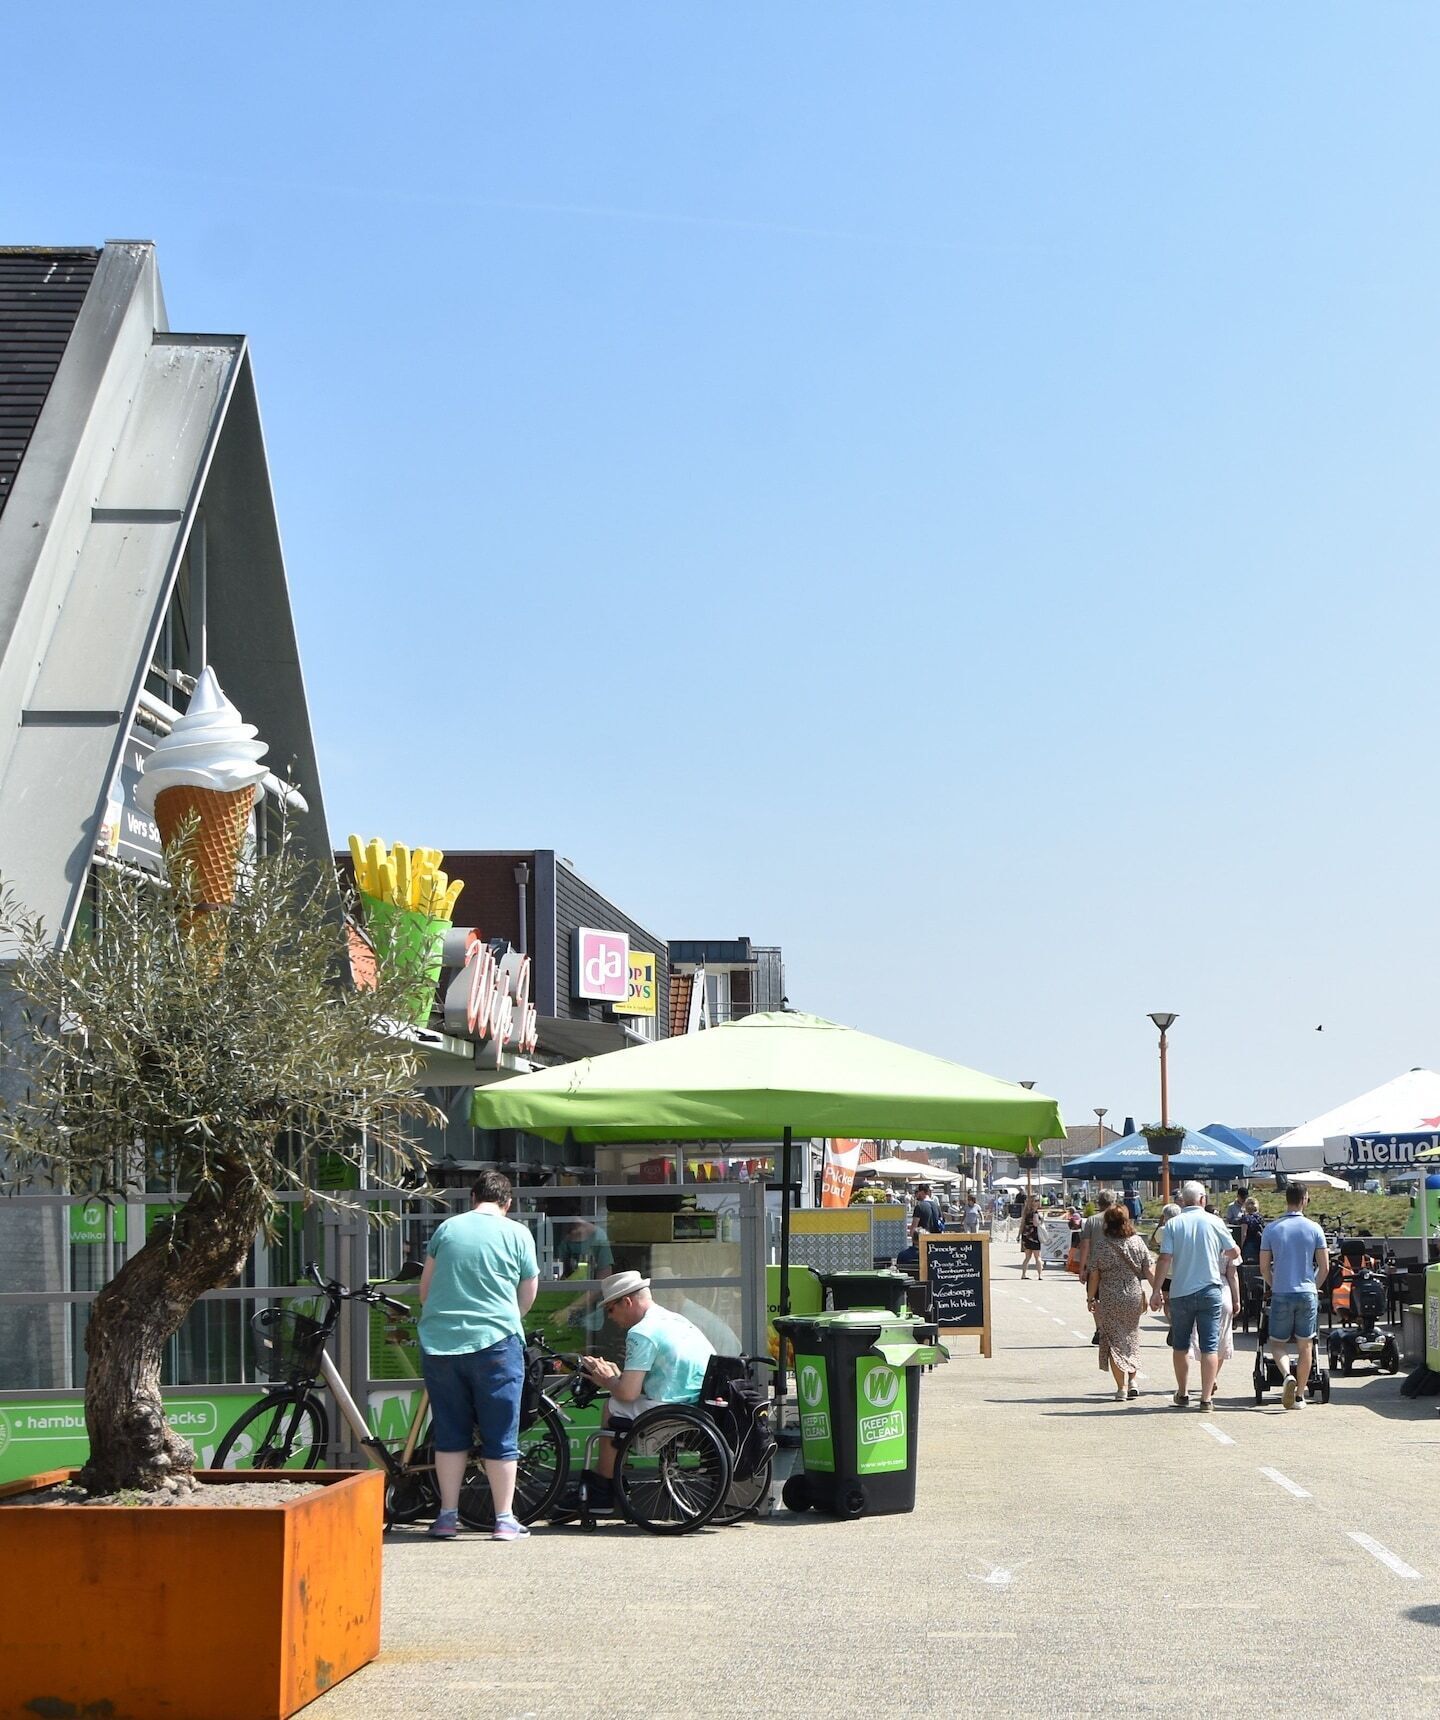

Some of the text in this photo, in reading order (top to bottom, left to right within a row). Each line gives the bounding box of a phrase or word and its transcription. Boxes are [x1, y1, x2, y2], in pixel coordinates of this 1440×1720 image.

[127, 812, 148, 836] Vers
[585, 943, 622, 986] da
[804, 1416, 826, 1426] KEEP IT
[863, 1414, 900, 1430] KEEP IT
[805, 1426, 826, 1436] CLEAN
[866, 1426, 899, 1441] CLEAN
